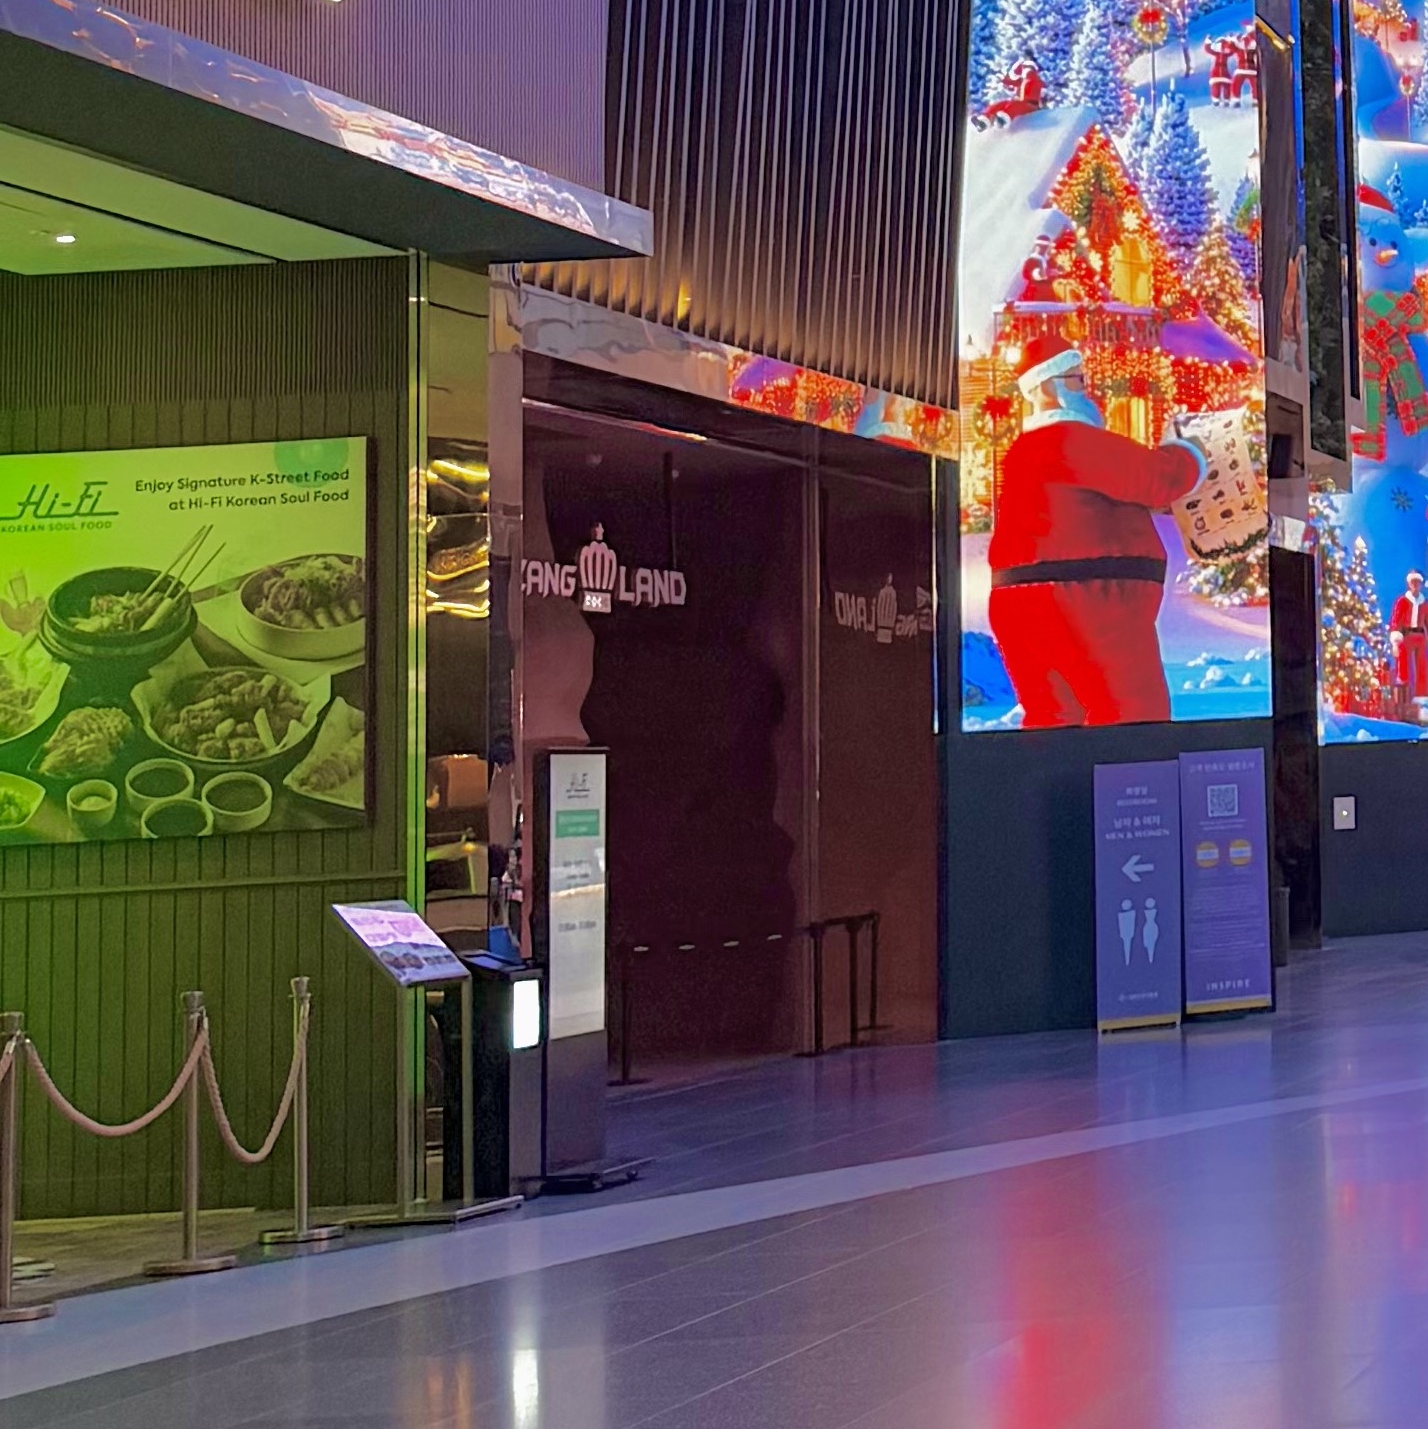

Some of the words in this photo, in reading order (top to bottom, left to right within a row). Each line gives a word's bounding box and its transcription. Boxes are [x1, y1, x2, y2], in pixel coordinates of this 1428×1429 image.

[135, 479, 174, 495] Enjoy
[177, 475, 246, 491] Signature
[249, 470, 310, 486] K-Street
[313, 469, 350, 483] Food
[0, 481, 119, 521] Hi-Fi
[168, 499, 185, 511] at
[188, 496, 222, 510] Hi-Fi
[226, 494, 277, 508] Korean
[280, 491, 310, 505] Soul
[313, 489, 350, 503] Food
[1, 524, 45, 534] KOREAN
[48, 522, 77, 532] SOUL
[81, 520, 112, 530] FOOD
[619, 566, 687, 607] LAND
